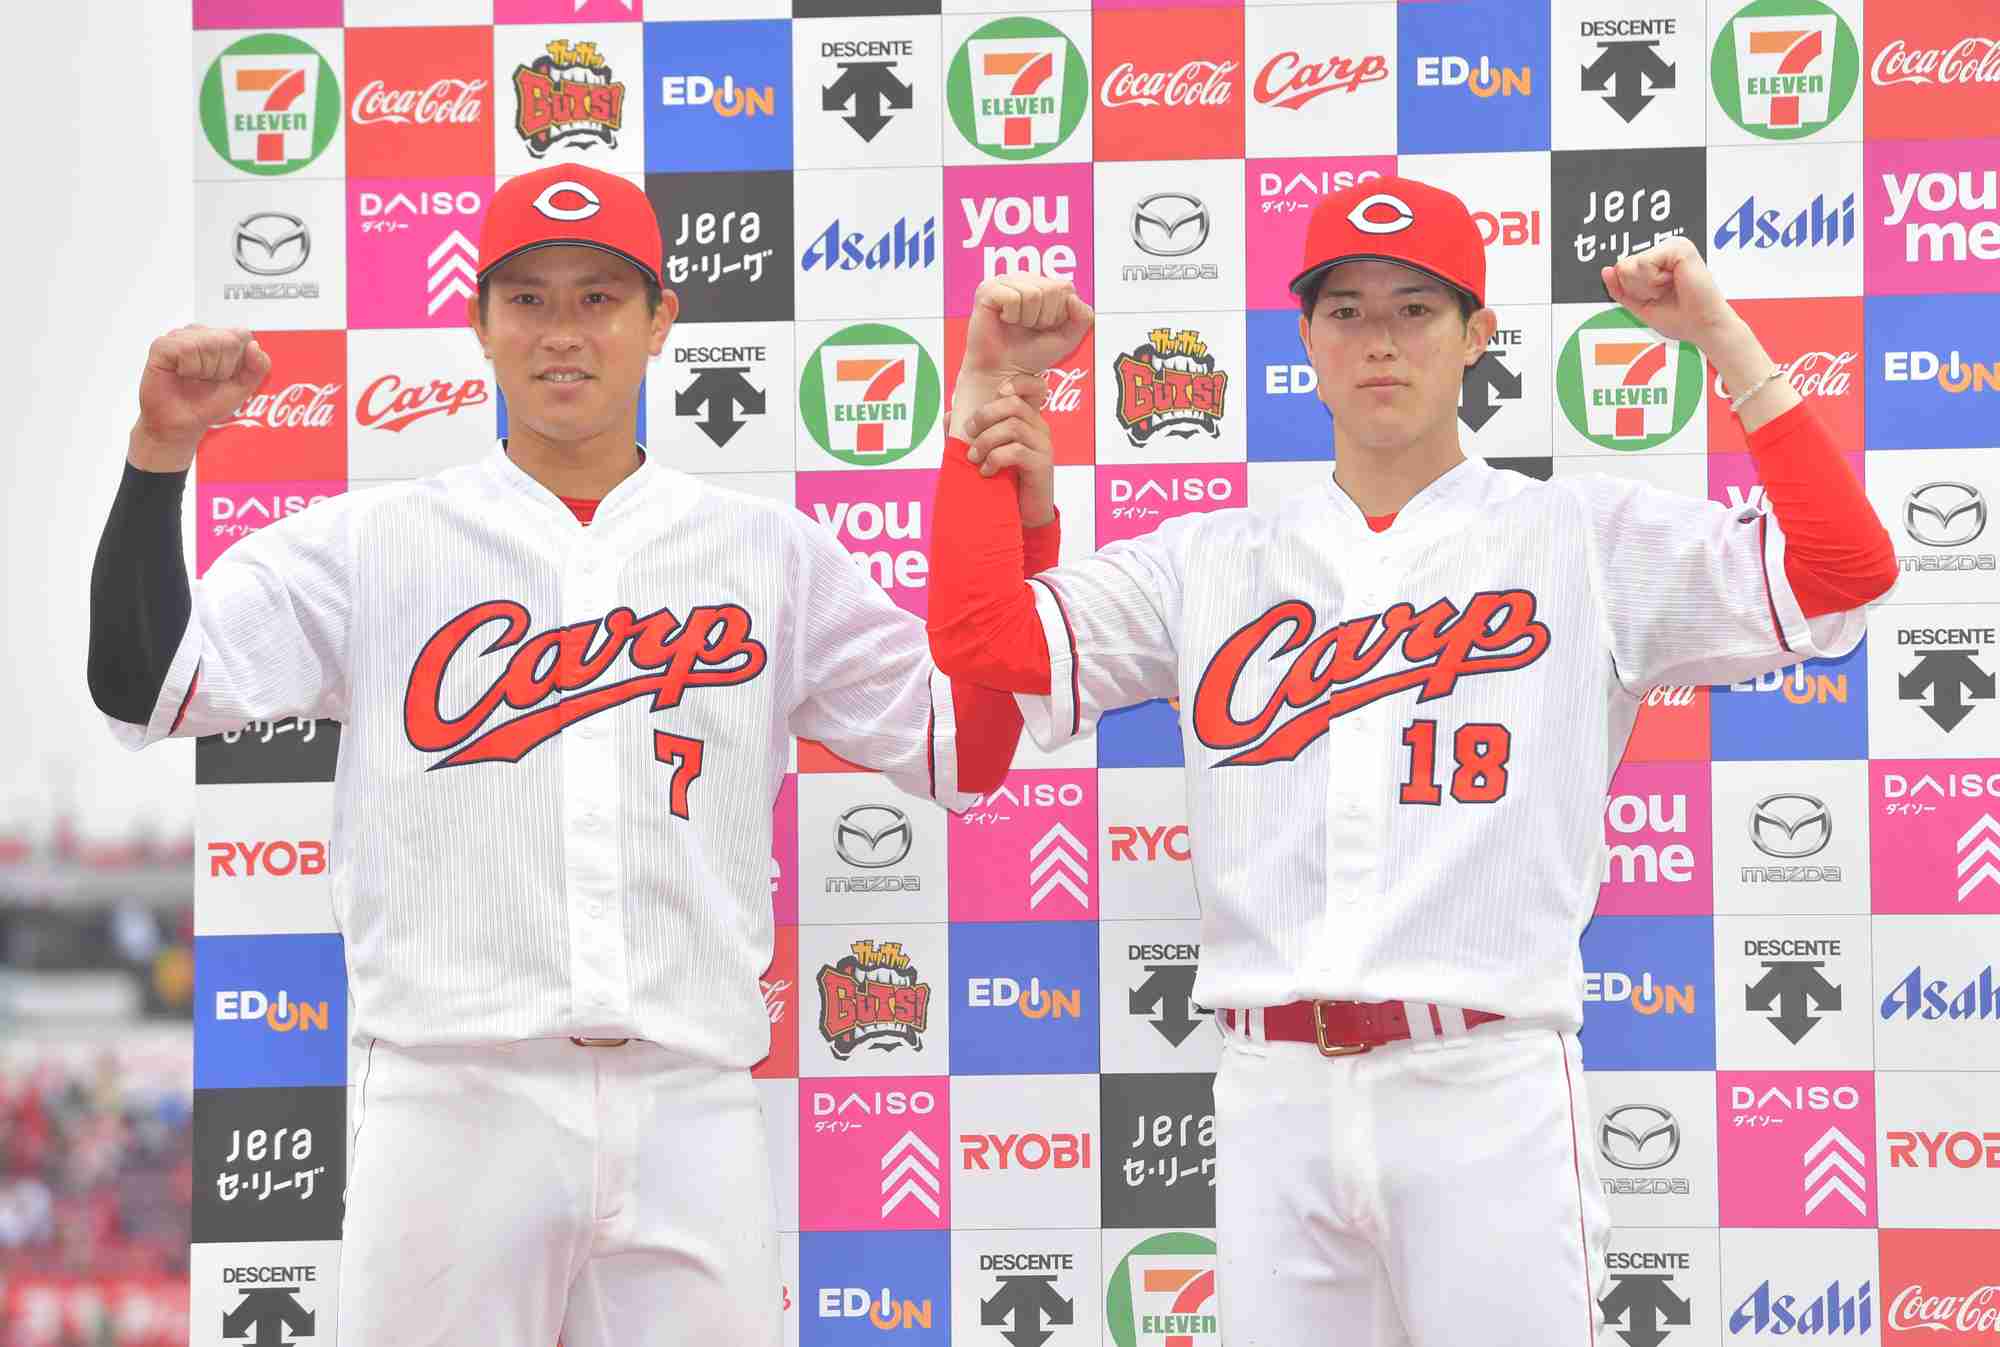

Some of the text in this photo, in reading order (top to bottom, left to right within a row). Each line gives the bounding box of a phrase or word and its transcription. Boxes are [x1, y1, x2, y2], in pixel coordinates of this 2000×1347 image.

[1581, 19, 1676, 37] DESCENTE
[821, 41, 912, 58] DESCENTE
[662, 75, 775, 117] EDION
[1100, 60, 1239, 107] Coca-Cola
[1254, 51, 1389, 110] Carp
[1417, 55, 1531, 97] EDION
[352, 79, 487, 124] Coca-Cola
[1881, 171, 1997, 226] you
[960, 195, 1069, 248] you
[1472, 211, 1540, 246] OBI
[1714, 192, 1855, 250] Asahi
[1905, 221, 2000, 262] me
[801, 216, 935, 272] Asahi
[983, 244, 1076, 281] me
[675, 347, 766, 363] DESCENTE
[1885, 350, 2000, 393] EDION
[356, 374, 488, 432] Carp
[212, 496, 330, 520] DAIS
[1898, 629, 1995, 645] DESCENTE
[404, 600, 767, 773] Carp
[1194, 589, 1551, 769] Carp
[1731, 664, 1847, 703] DION
[653, 729, 704, 820] 7
[1399, 719, 1511, 806] 18
[1602, 795, 1687, 833] ou
[208, 841, 327, 877] RYOB
[1109, 825, 1191, 861] RYO
[1600, 843, 1695, 883] me
[1129, 944, 1200, 960] DESCEN
[1745, 940, 1841, 957] DESCENTE
[216, 990, 328, 1031] EDION
[968, 977, 1081, 1019] EDION
[1881, 966, 2000, 1020] Asah
[960, 1133, 1090, 1169] RYOBI
[223, 1266, 316, 1283] DESCENTE
[980, 1254, 1073, 1270] DESCENTE
[1604, 1252, 1690, 1269] ESCENTE
[819, 1287, 932, 1329] EDION
[1729, 1279, 1871, 1336] Asahi
